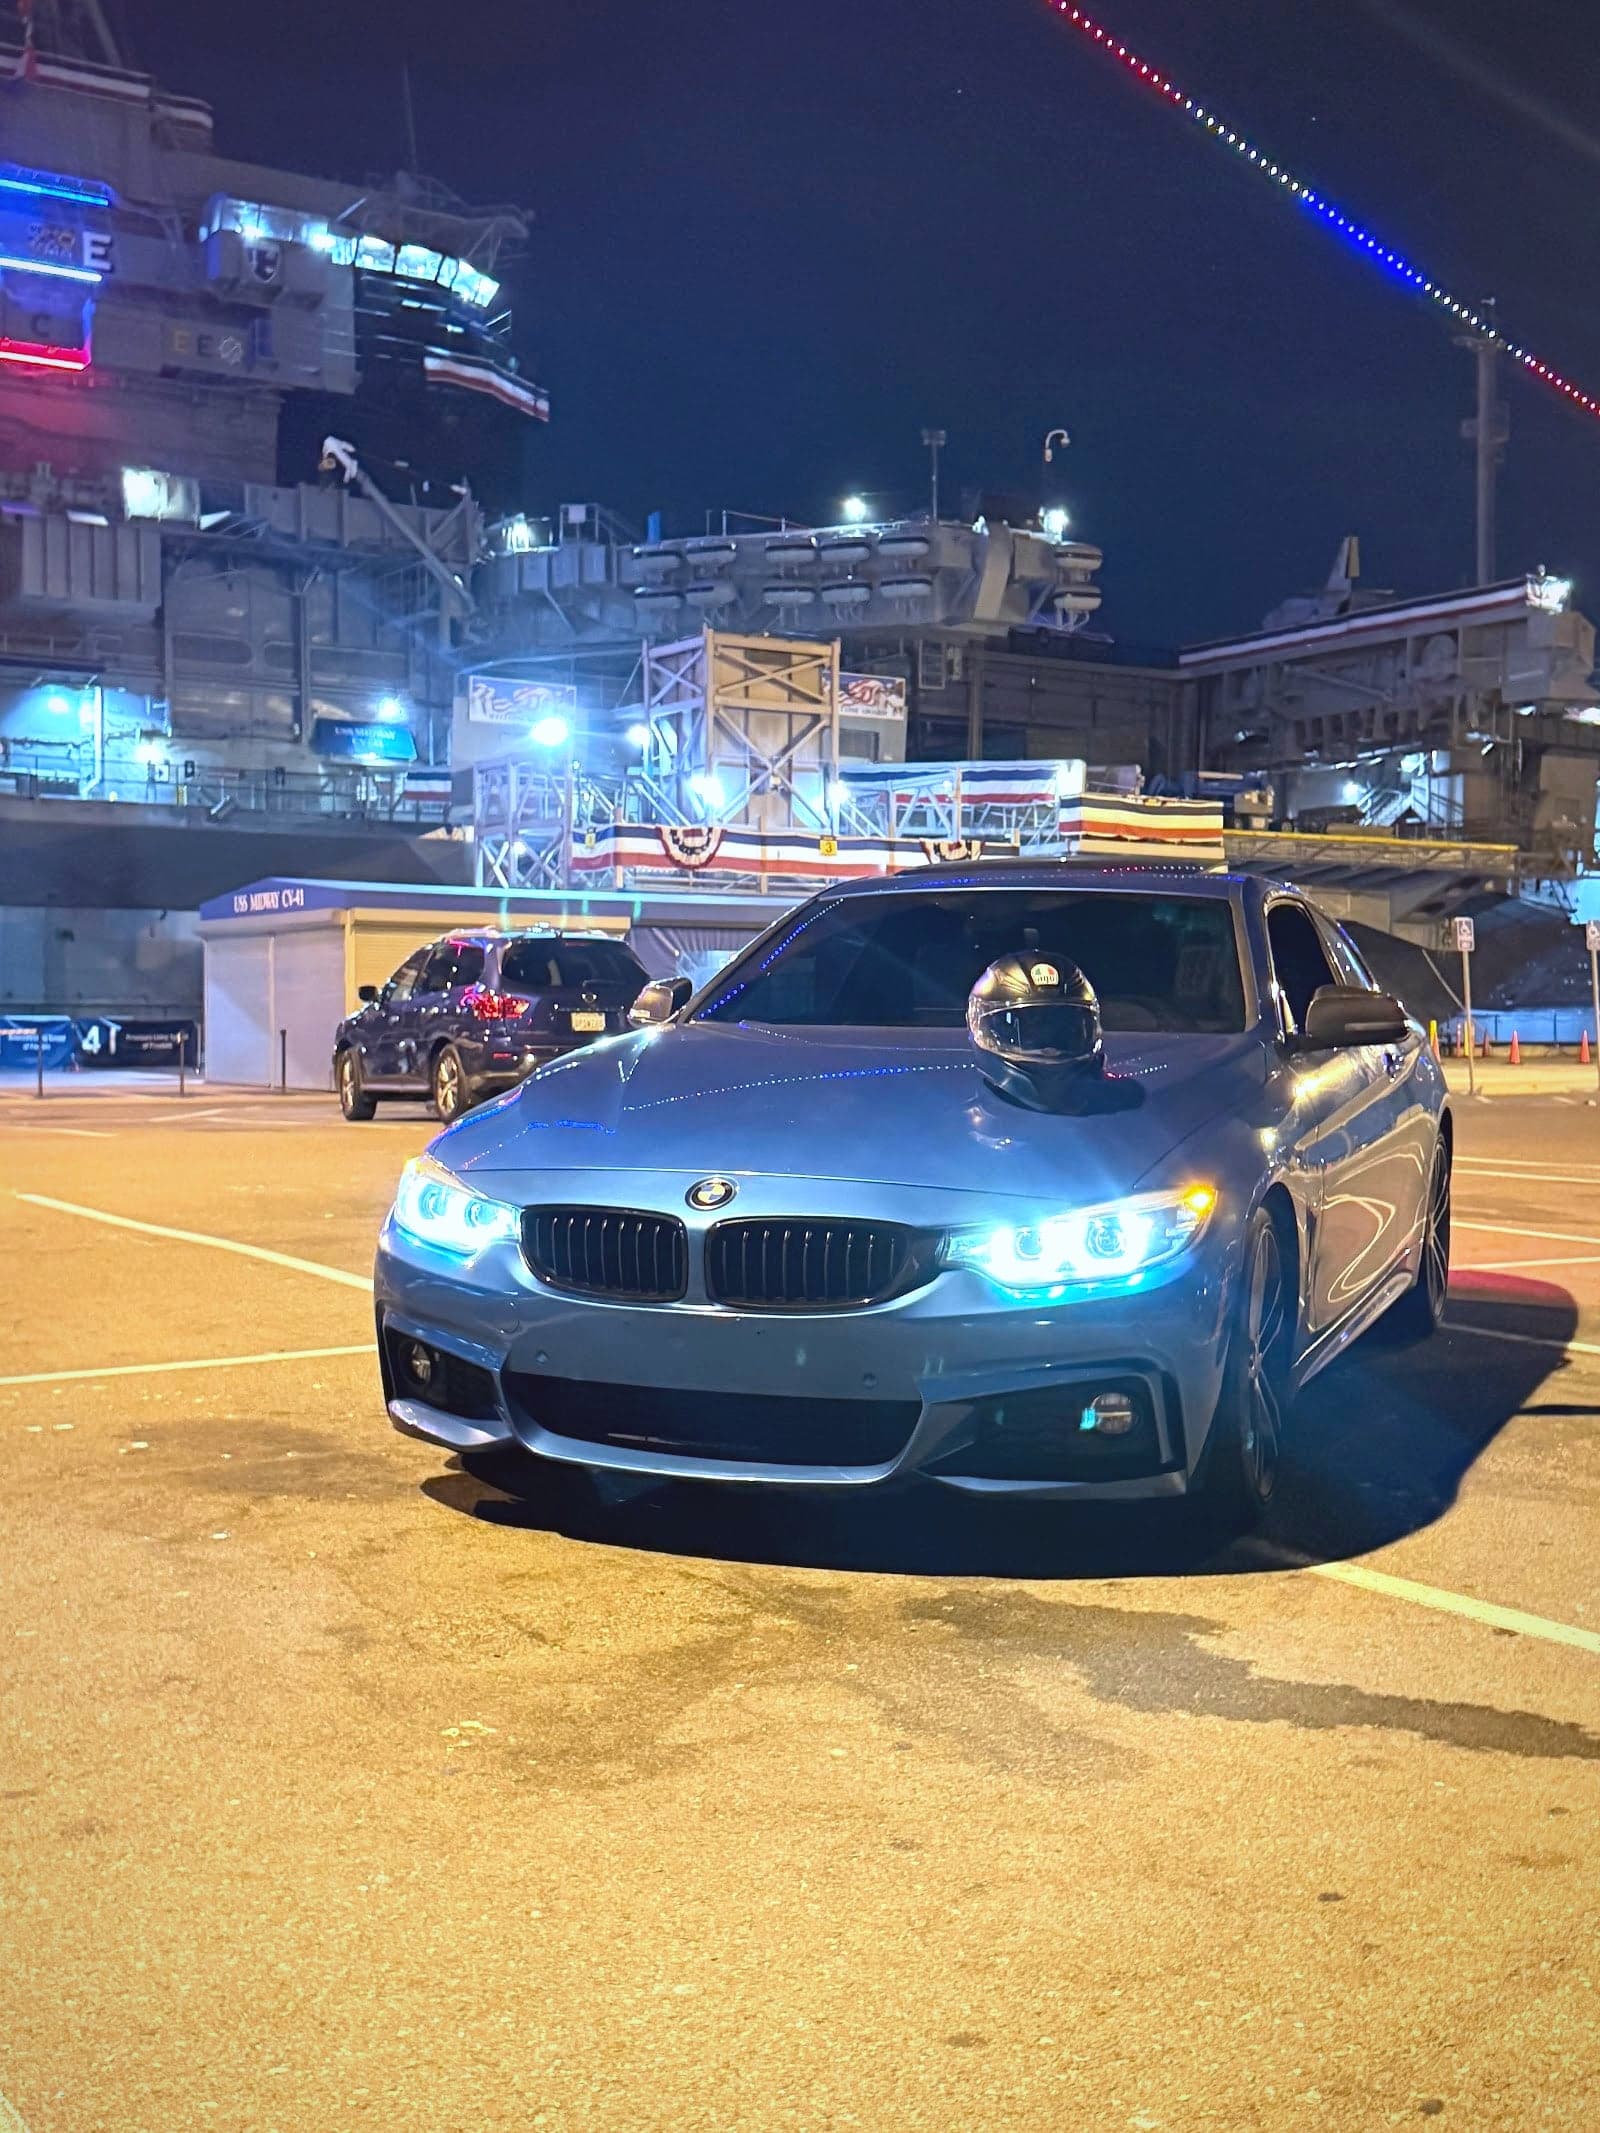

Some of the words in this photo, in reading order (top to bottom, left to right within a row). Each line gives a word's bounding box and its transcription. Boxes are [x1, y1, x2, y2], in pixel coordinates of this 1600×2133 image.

[83, 231, 113, 271] E
[233, 894, 248, 913] USS
[249, 891, 280, 912] MIDWAY
